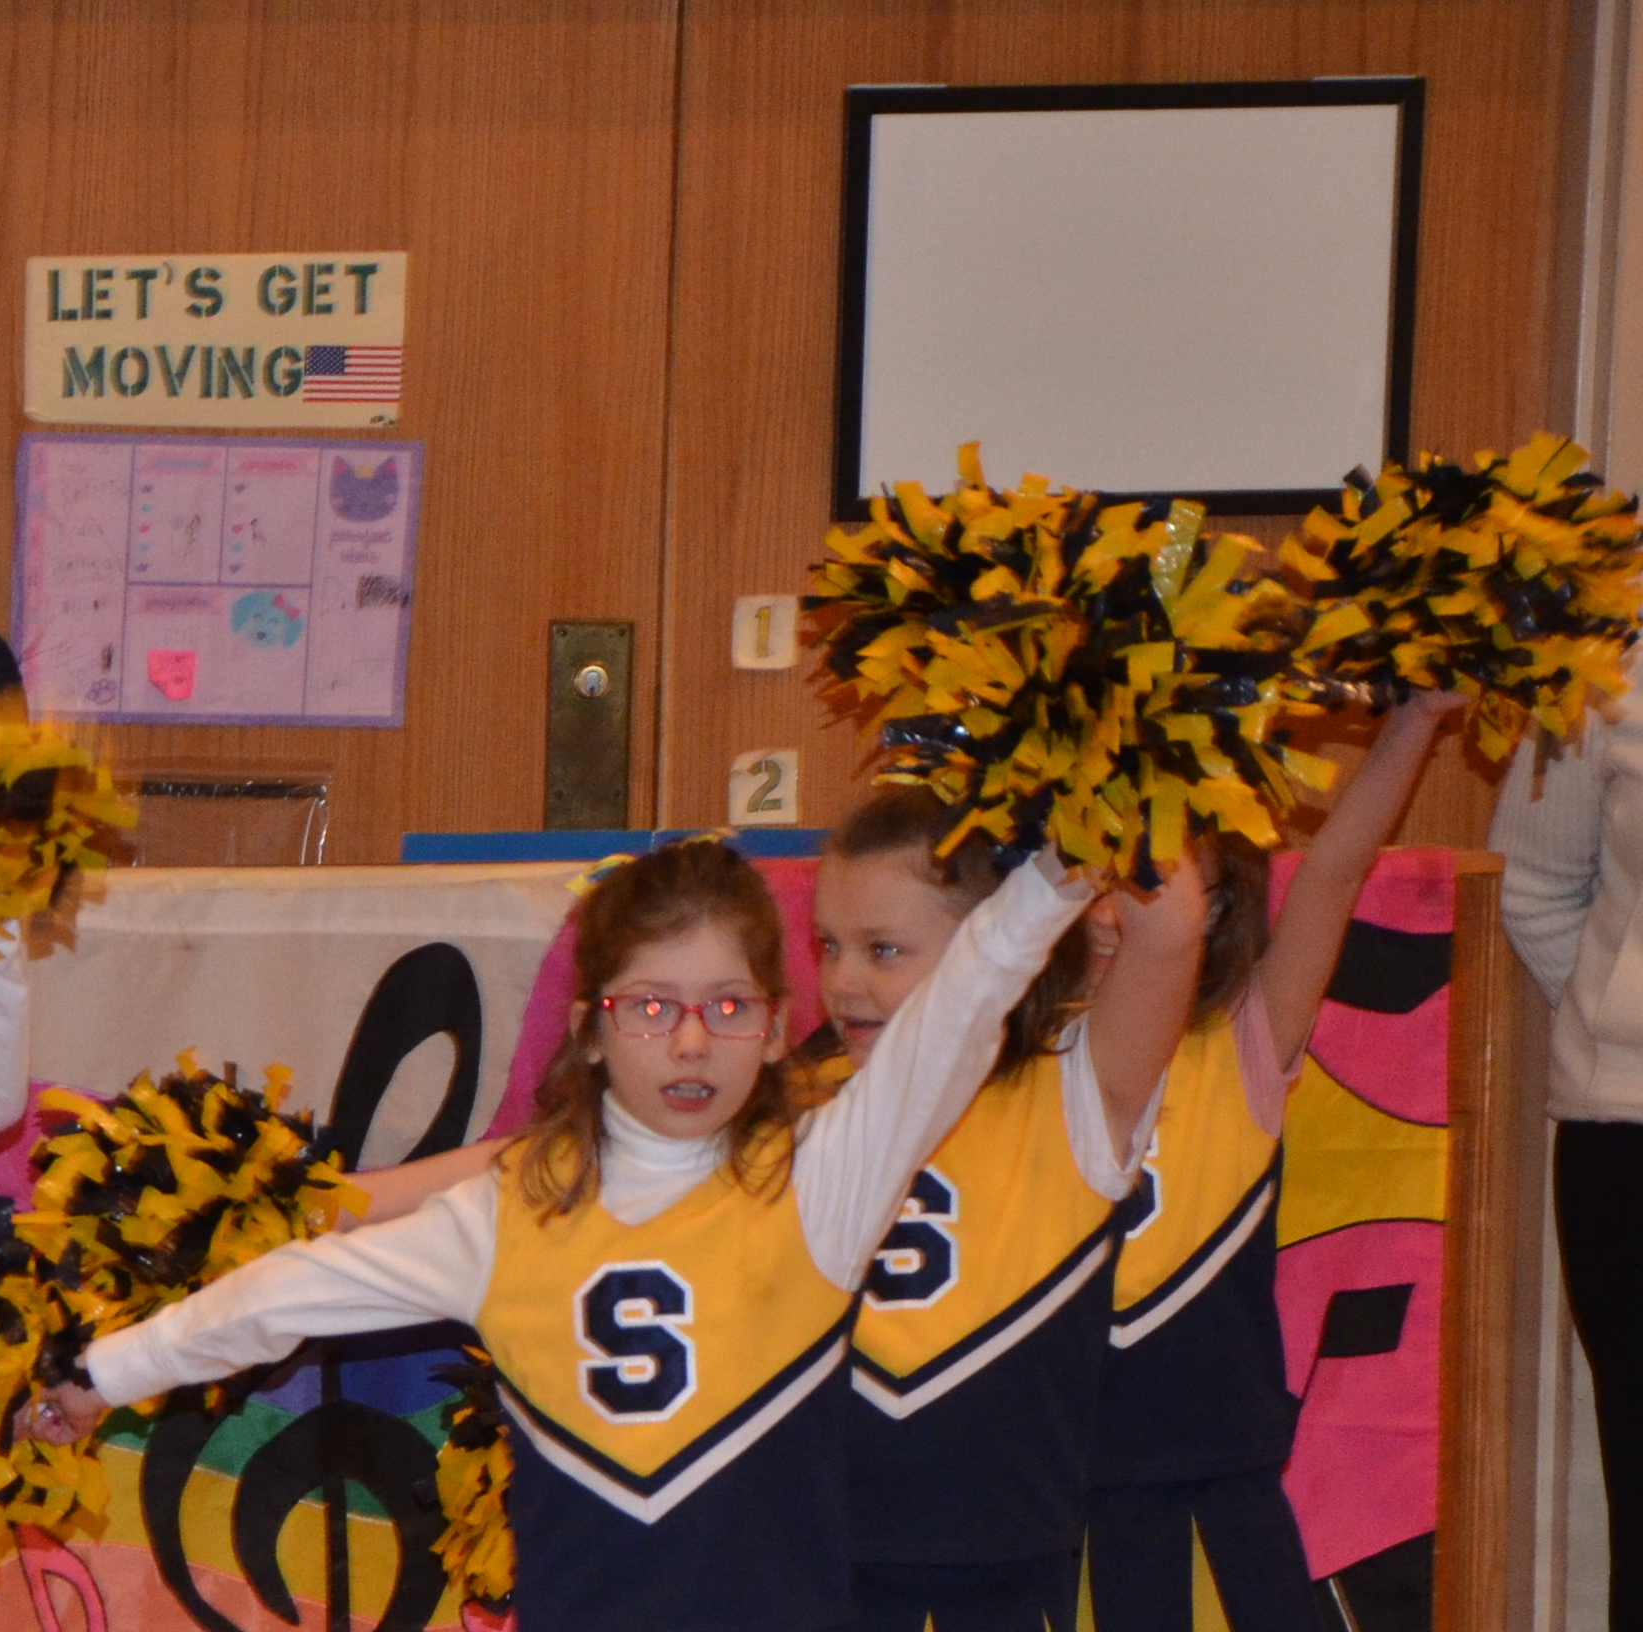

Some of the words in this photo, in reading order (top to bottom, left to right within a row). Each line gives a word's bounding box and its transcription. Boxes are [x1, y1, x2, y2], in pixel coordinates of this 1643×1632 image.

[48, 262, 223, 321] LET'S
[257, 263, 379, 316] GET
[62, 345, 305, 399] MOVING
[755, 606, 771, 658] 1
[747, 759, 782, 813] 2
[573, 1260, 696, 1424] S
